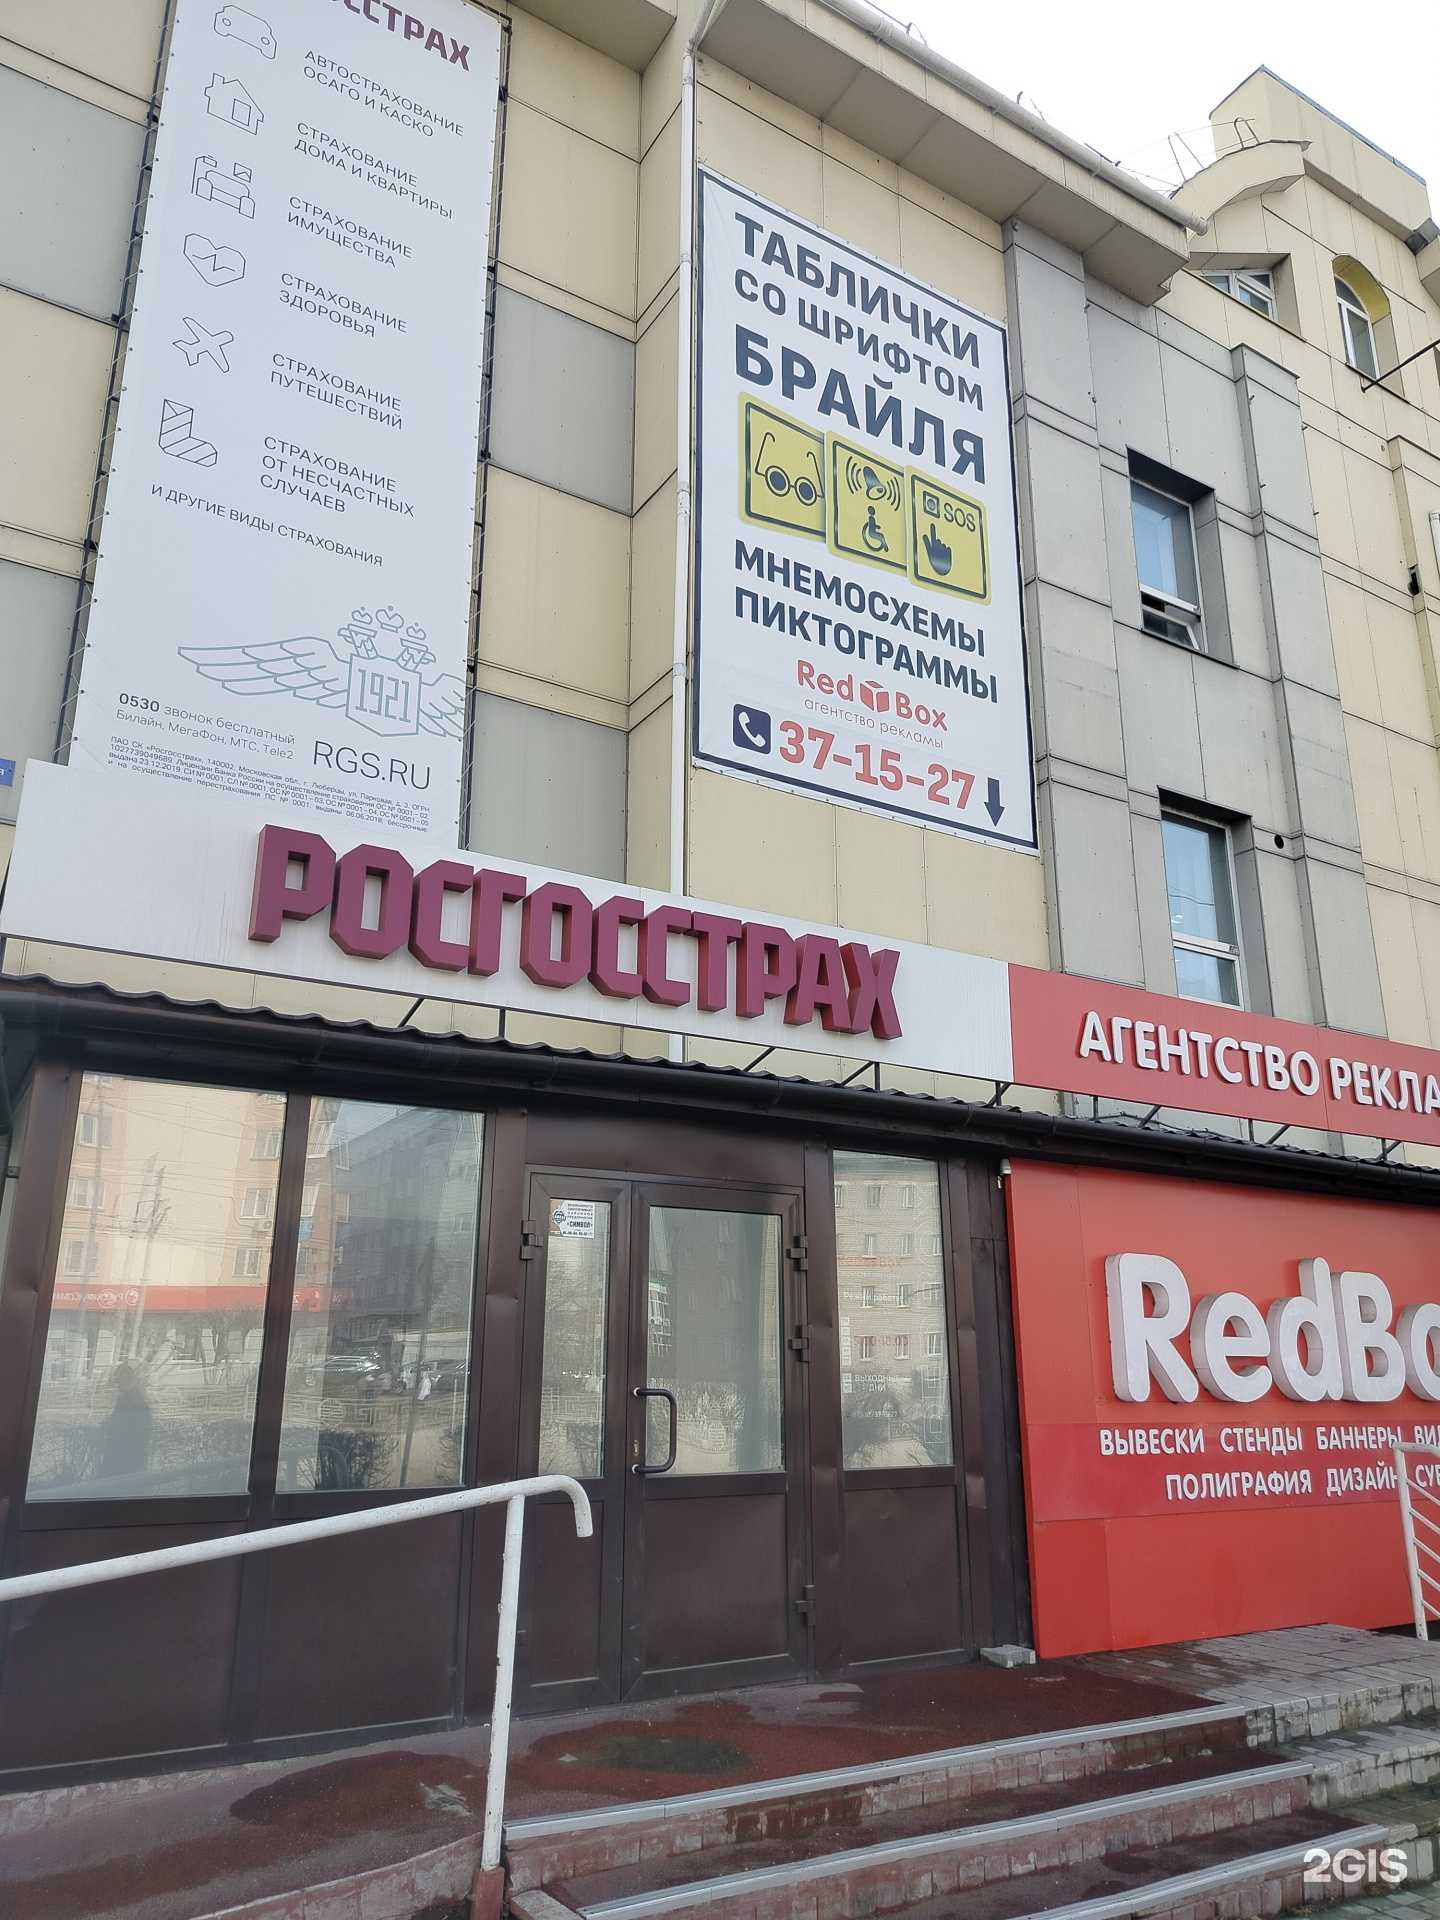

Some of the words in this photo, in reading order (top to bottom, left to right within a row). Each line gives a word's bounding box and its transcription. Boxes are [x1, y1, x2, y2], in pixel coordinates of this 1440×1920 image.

[303, 66, 360, 101] ОСАГО
[364, 95, 376, 109] И
[380, 103, 433, 137] КАСКО
[305, 50, 465, 137] АВТОСТРАХОВАНИЕ
[294, 139, 347, 171] ДОМА
[351, 164, 362, 178] И
[367, 171, 453, 220] КВАРТИРЫ
[297, 122, 418, 187] СТРАХОВАНИЕ
[288, 212, 396, 268] ИМУЩЕСТВА
[289, 196, 413, 260] СТРАХОВАНИЕ
[279, 289, 376, 338] ЗДОРОВЬЯ
[281, 273, 408, 334] СТРАХОВАНИЕ
[735, 212, 980, 368] ТАБЛИЧКИ
[735, 268, 786, 316] СО
[798, 297, 984, 412] ШРИФТОМ
[270, 370, 403, 430] ПУТЕШЕСТВИЙ
[272, 353, 402, 412] СТРАХОВАНИЕ
[735, 323, 986, 485] БРАЙЛЯ
[260, 474, 346, 513] СЛУЧАЕВ
[262, 455, 288, 473] ОТ
[292, 464, 415, 518] НЕСЧАСТНЫХ
[264, 436, 398, 493] СТРАХОВАНИЕ
[151, 484, 163, 497] И
[165, 489, 226, 518] ДРУГИЕ
[229, 508, 274, 533] ВИДЫ
[277, 524, 384, 567] СТРАХОВАНИЯ
[943, 502, 977, 532] SOS
[735, 539, 986, 658] МНЕМОСХЕМЫ
[735, 586, 998, 704] ПИКТОГРАММЫ
[119, 693, 160, 712] 0530
[164, 706, 213, 725] звонок
[216, 717, 295, 745] бесплатный
[797, 660, 855, 702] Red
[895, 692, 948, 732] Box
[804, 698, 876, 730] агентство
[879, 721, 944, 750] рекламы
[263, 744, 294, 760] Tele2
[313, 740, 431, 790] RGS.RU
[779, 720, 976, 810] 37-15-27
[248, 823, 903, 1040] РОСГОССТРАХ
[1079, 1011, 1321, 1097] АГЕНТСТВО
[1099, 1427, 1205, 1456] ВЫВЕСКИ
[1220, 1426, 1303, 1456] СТЕНДЫ
[1316, 1425, 1402, 1451] БАННЕРЫ
[1414, 1425, 1440, 1448] ВИ
[1165, 1469, 1312, 1501] ПОЛИГРАФИЯ
